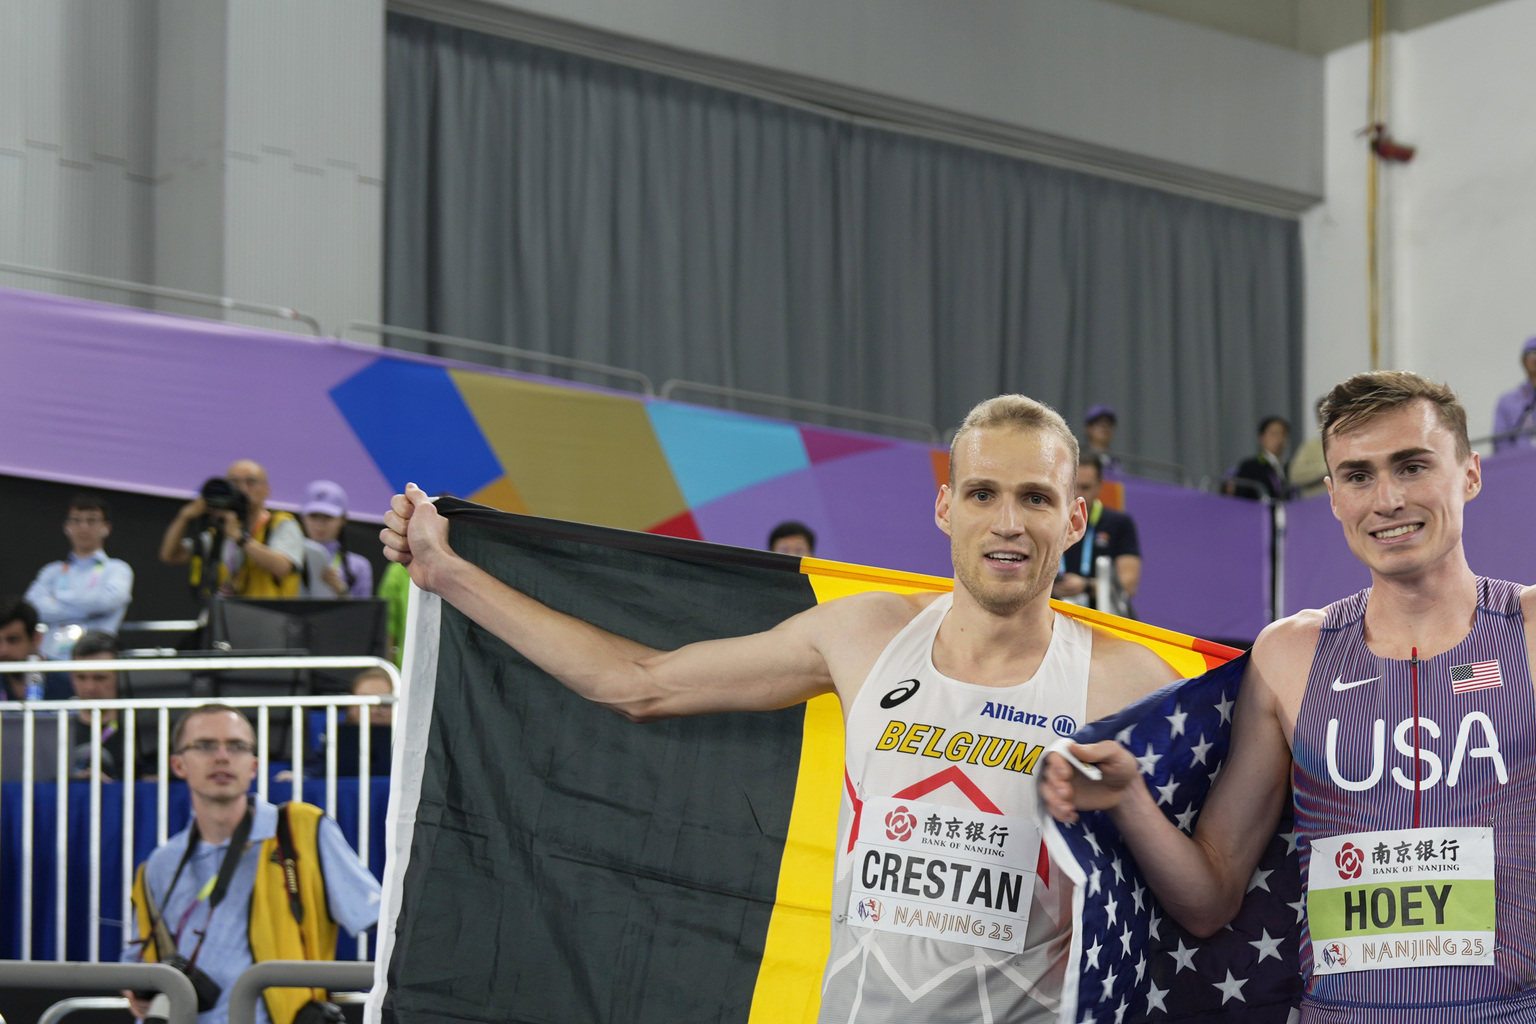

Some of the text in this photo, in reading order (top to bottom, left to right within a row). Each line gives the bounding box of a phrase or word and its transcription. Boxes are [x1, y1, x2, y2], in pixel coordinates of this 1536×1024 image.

[980, 701, 1048, 728] Allianz
[875, 720, 1045, 776] BELGIUM
[1326, 710, 1509, 792] USA
[921, 837, 1005, 858] BANK OF NANJING
[923, 813, 1010, 848] 南京银行
[1371, 839, 1460, 866] 南京银行
[1372, 863, 1460, 875] BANK OF NANJING
[861, 849, 1023, 914] CRESTAN
[893, 905, 1013, 942] NANJING 25
[1344, 884, 1453, 931] HOEY
[1362, 935, 1484, 963] NANJING 25
